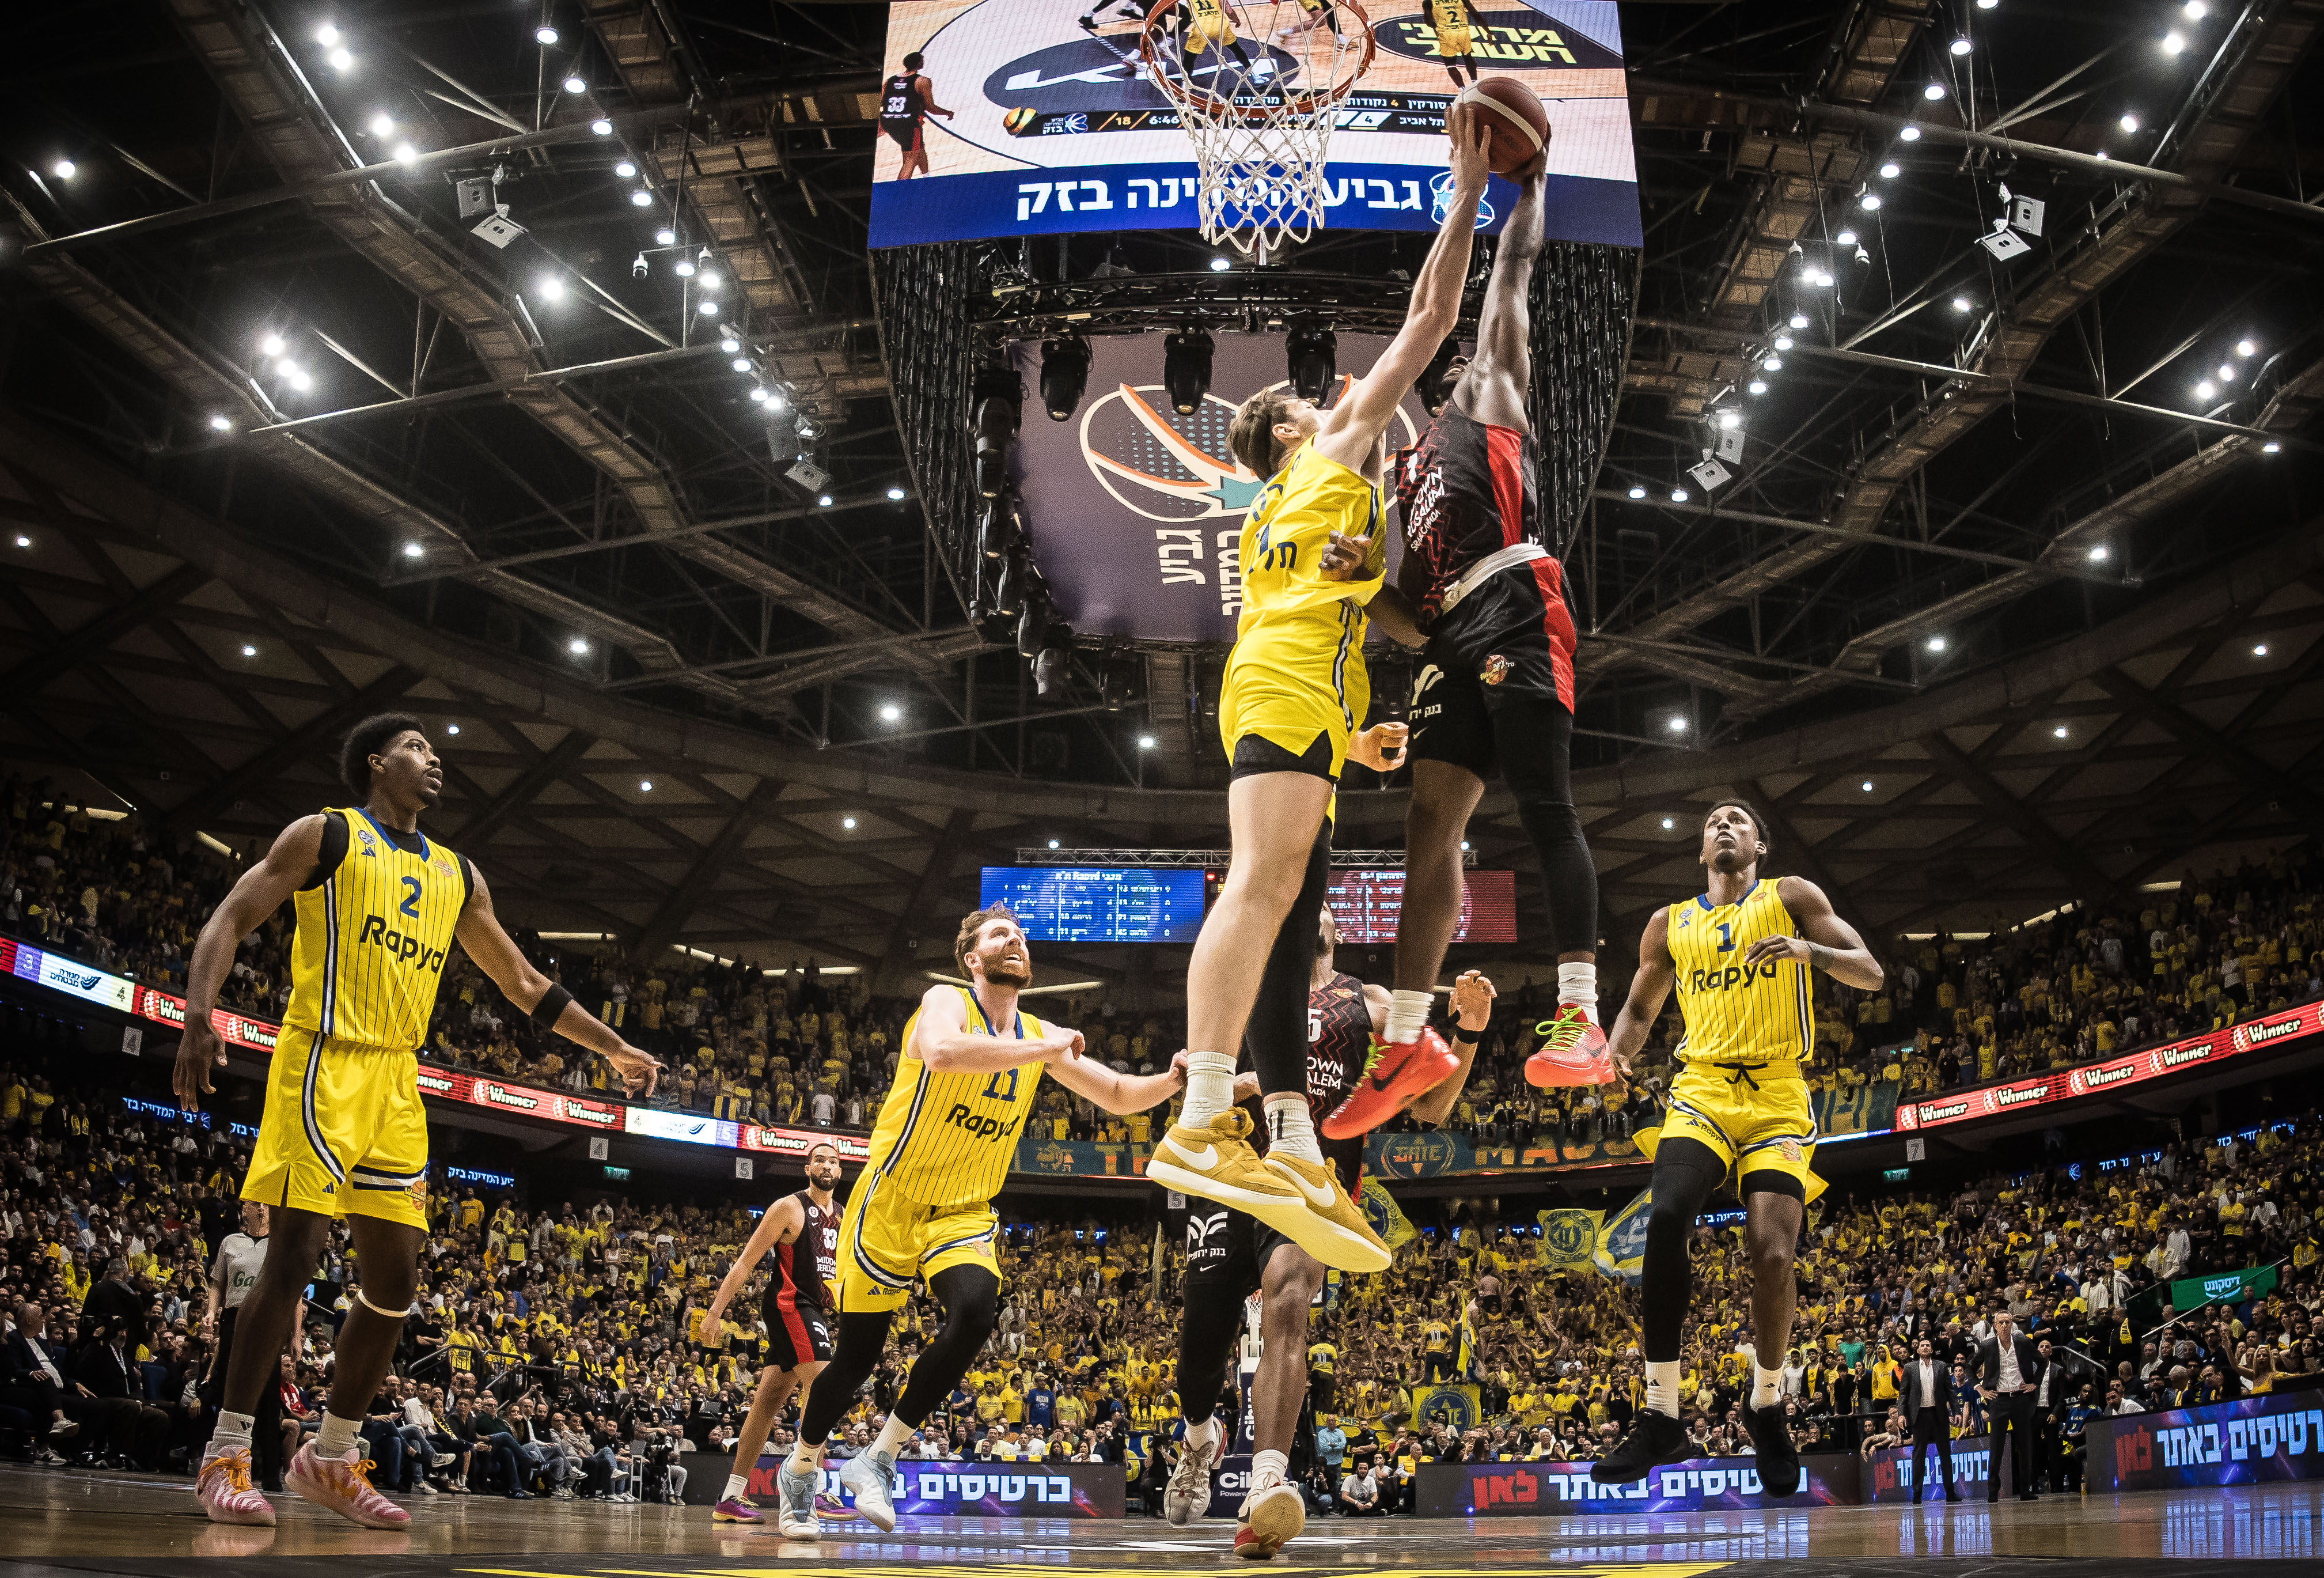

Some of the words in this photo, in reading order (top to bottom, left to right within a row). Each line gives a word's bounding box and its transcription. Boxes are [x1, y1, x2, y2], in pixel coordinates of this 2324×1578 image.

[1447, 11, 1459, 23] 2
[888, 97, 907, 112] 33
[1116, 116, 1131, 126] 18
[1149, 115, 1180, 125] 6:46
[1400, 116, 1428, 126] אביב
[1017, 180, 1114, 221] בזק
[399, 876, 422, 919] 2
[359, 914, 446, 974] Rapyd
[1716, 923, 1736, 952] 1
[1692, 963, 1777, 996] Rapyd
[116, 986, 126, 1002] 4
[2247, 1017, 2302, 1044] Winner
[2162, 1043, 2212, 1066] Winner
[982, 1068, 1019, 1102] 11
[2085, 1064, 2135, 1088] Winner
[488, 1084, 538, 1110] Winner
[1997, 1085, 2048, 1106] Winner
[567, 1101, 616, 1125] Winner
[945, 1103, 1020, 1142] Rapyd
[1919, 1103, 1967, 1122] Winner
[760, 1129, 809, 1151] Winner
[1909, 1142, 1921, 1160] 7
[739, 1161, 749, 1178] 5
[822, 1227, 837, 1250] 33
[1210, 1247, 1226, 1257] בנק
[2204, 1275, 2240, 1293] דיסקונט
[2156, 1422, 2222, 1467] באתר
[2227, 1409, 2324, 1462] רטיסים
[920, 1473, 1071, 1503] כרטיסים
